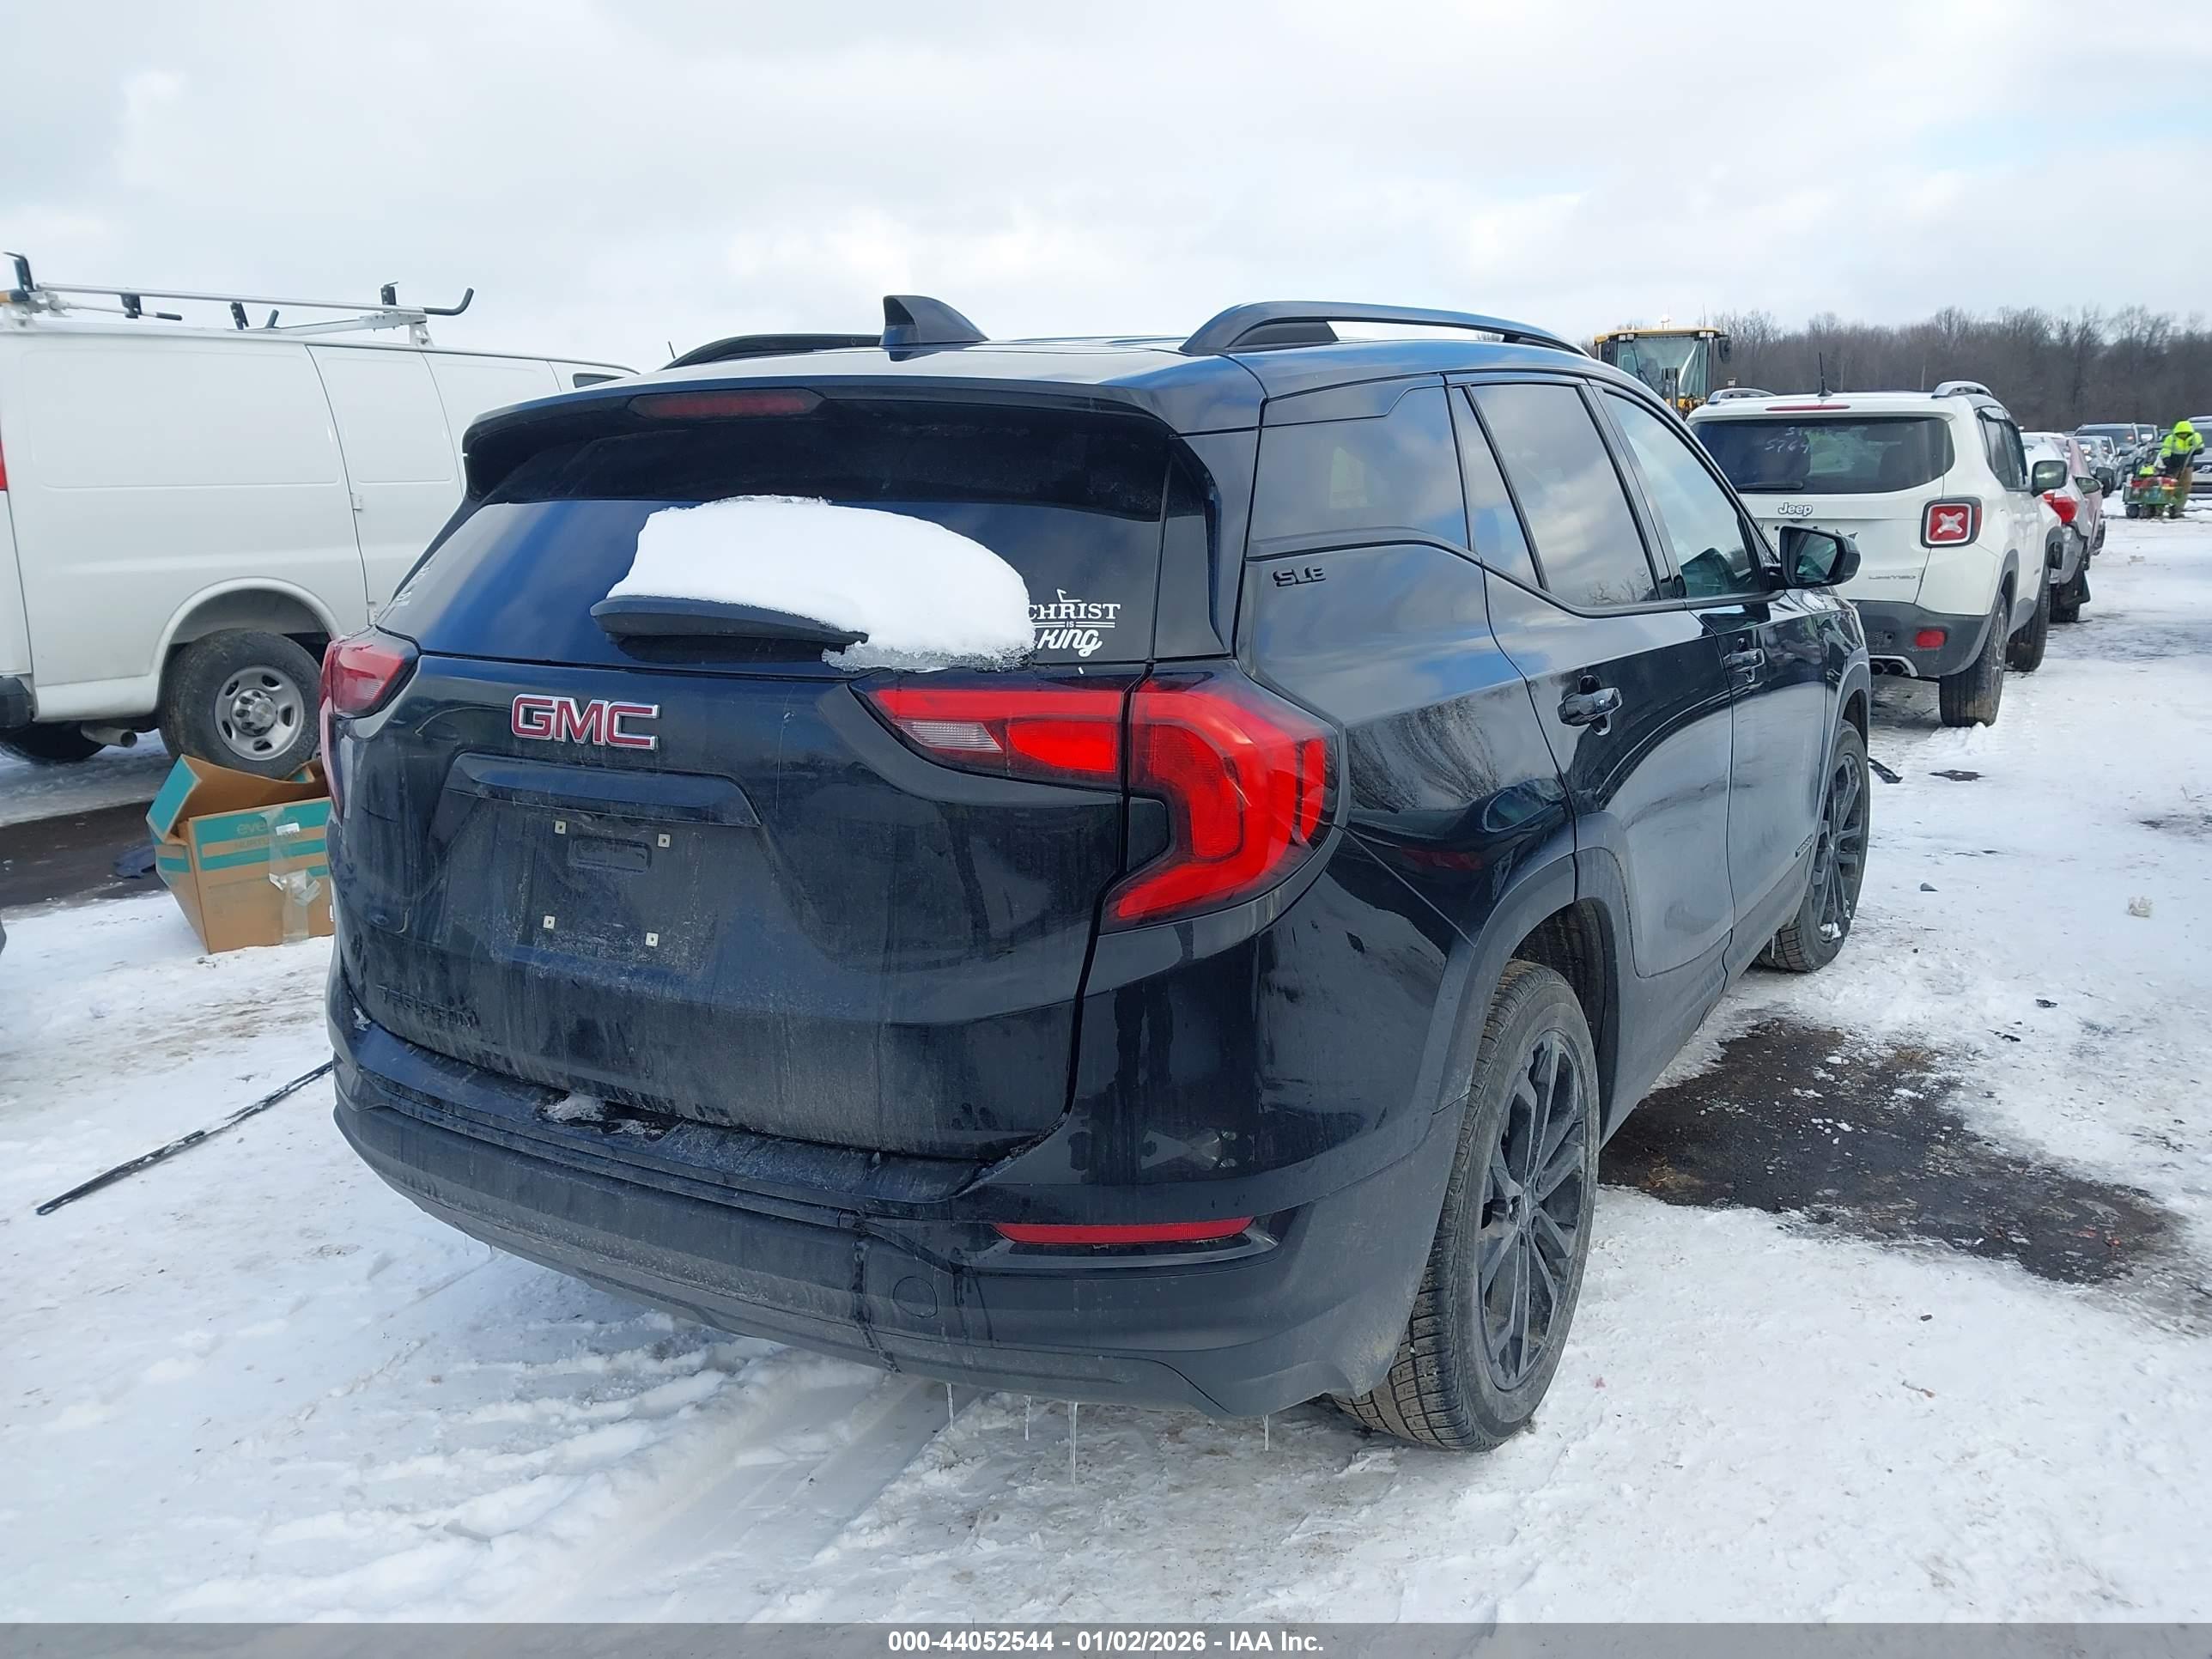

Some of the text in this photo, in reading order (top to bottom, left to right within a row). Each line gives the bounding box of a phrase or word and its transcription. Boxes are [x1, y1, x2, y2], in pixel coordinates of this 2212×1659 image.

[1778, 501, 1814, 517] Jeep
[1273, 567, 1326, 587] SLE
[1028, 603, 1121, 620] CHRIST
[511, 693, 660, 750] GMC
